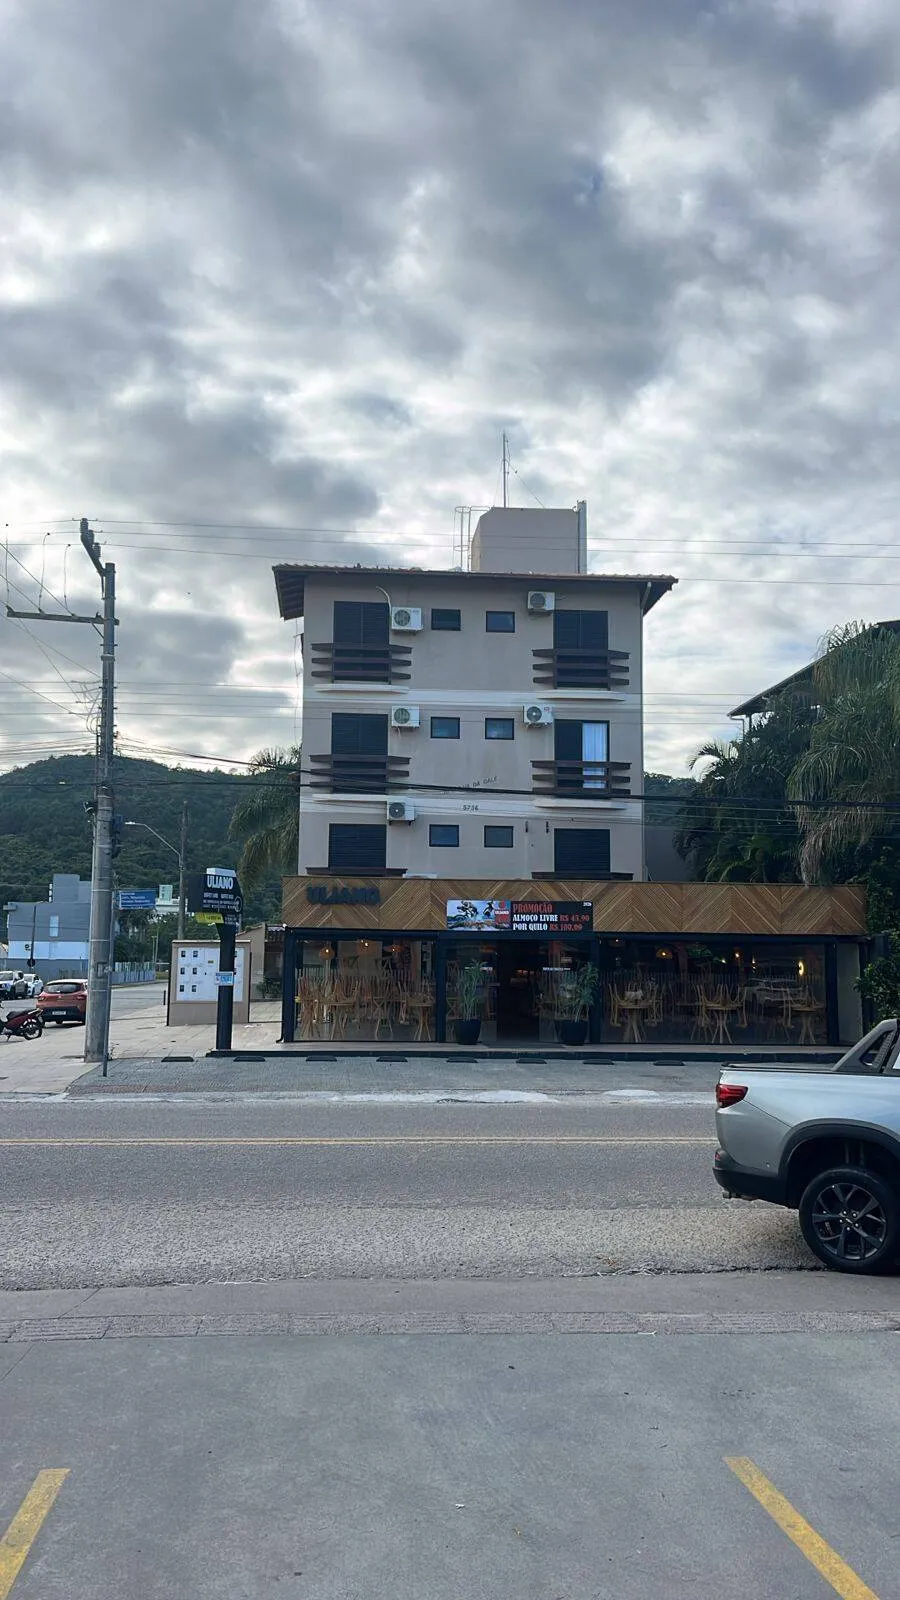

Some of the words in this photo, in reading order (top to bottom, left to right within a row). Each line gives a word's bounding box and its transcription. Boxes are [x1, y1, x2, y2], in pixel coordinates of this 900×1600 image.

[207, 875, 234, 890] ULIANO
[306, 886, 381, 906] ULIANO
[512, 902, 553, 914] PROMOÇÃO
[512, 914, 538, 922] ALMOÇO
[539, 914, 559, 922] LIVRE
[512, 923, 528, 931] POR
[529, 923, 548, 931] QUILO
